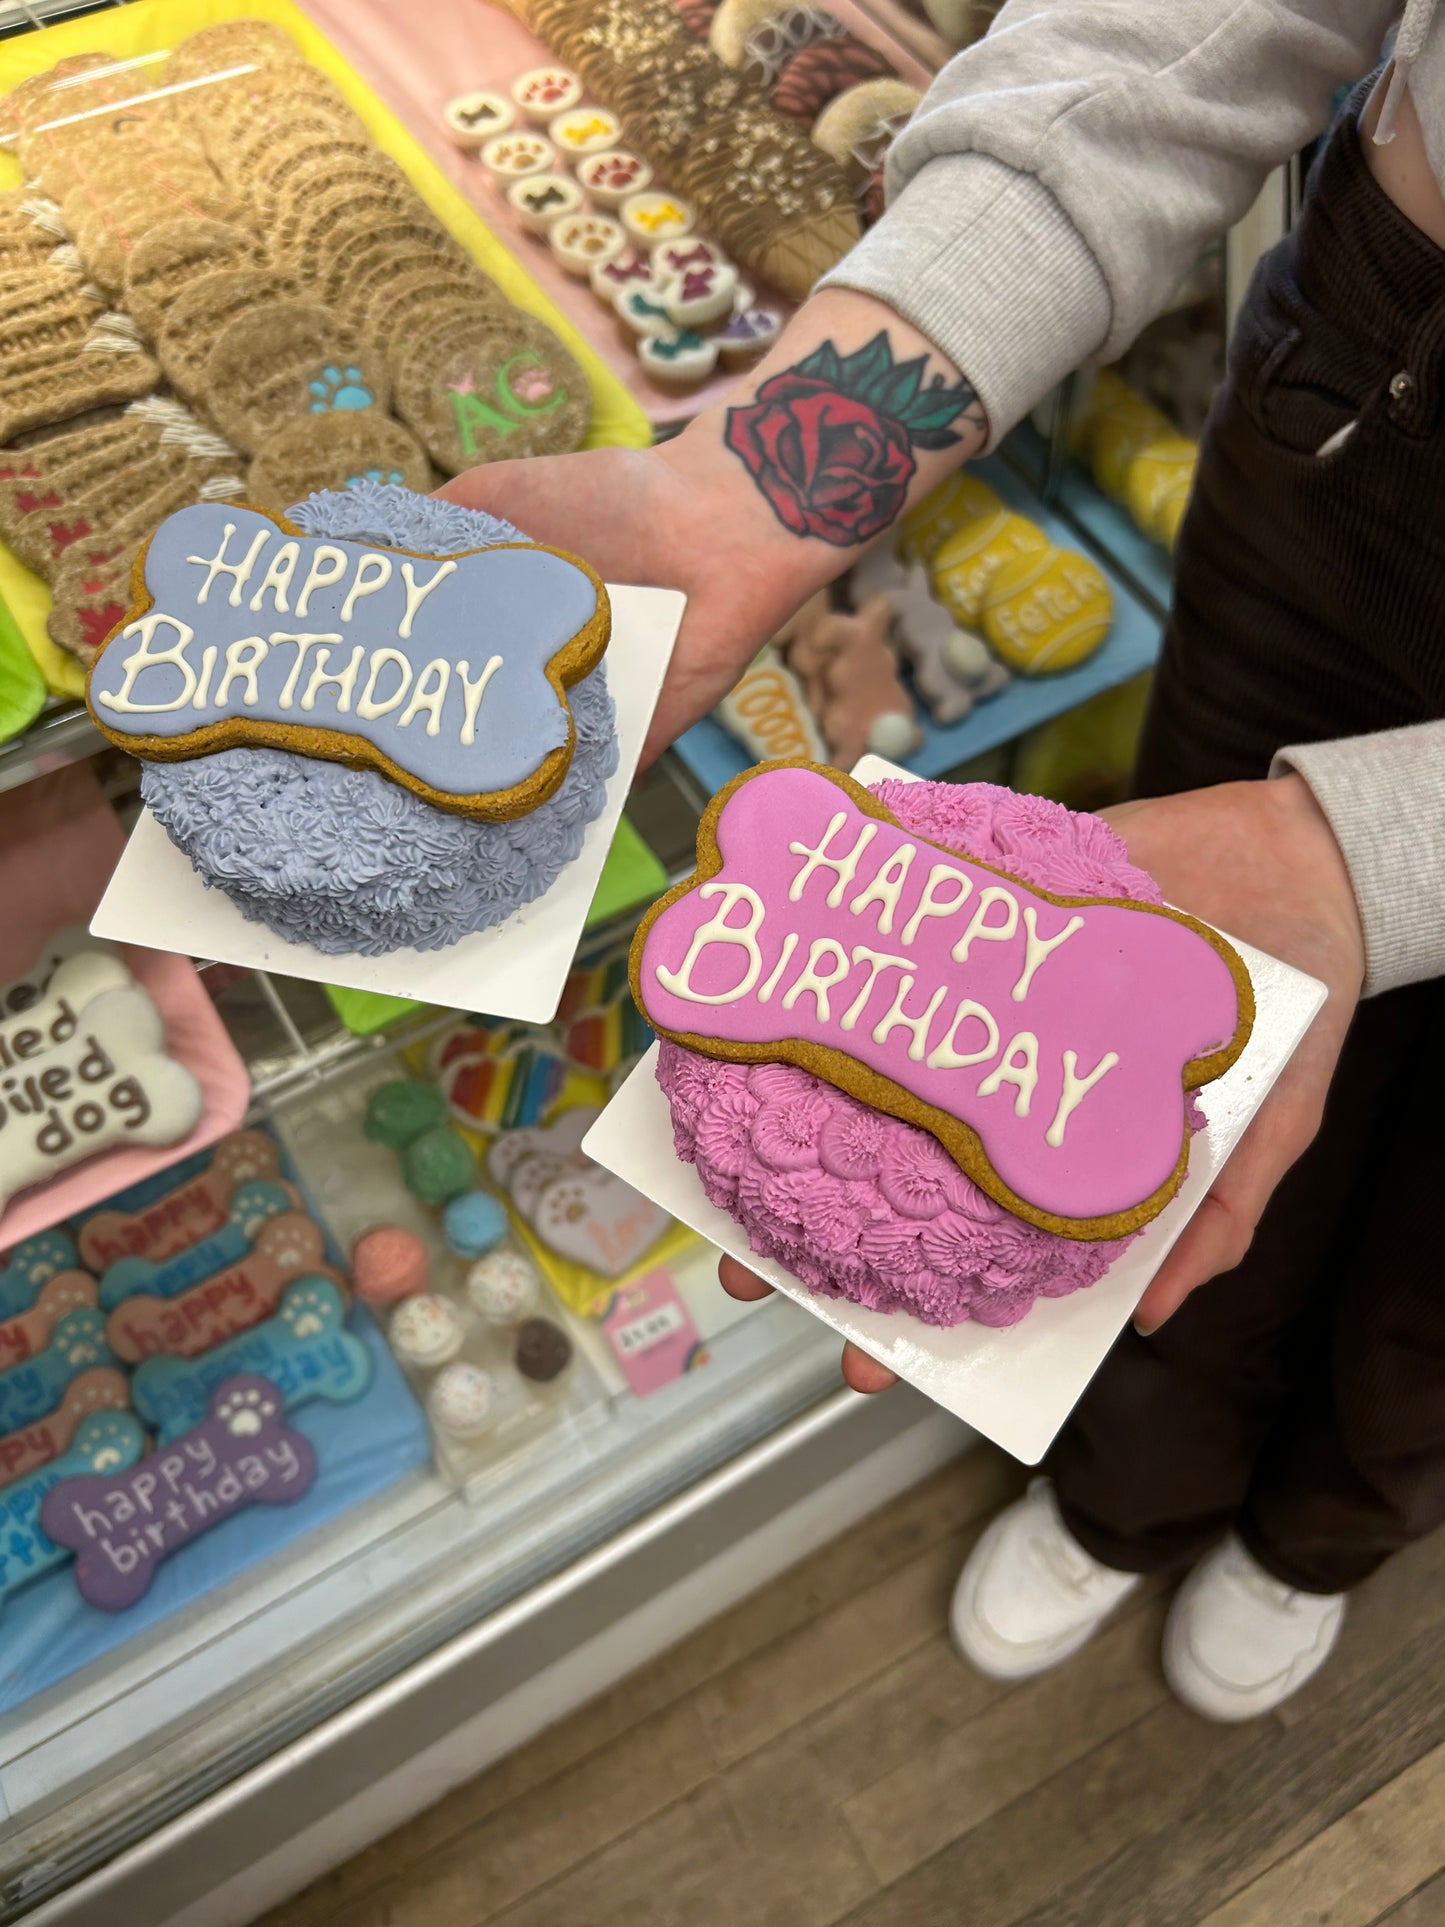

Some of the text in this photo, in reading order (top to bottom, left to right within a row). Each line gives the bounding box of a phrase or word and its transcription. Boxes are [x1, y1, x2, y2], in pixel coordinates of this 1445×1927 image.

[447, 347, 568, 457] AC
[186, 523, 458, 639] HAPPY
[98, 612, 504, 746] BIRTHDAY
[788, 811, 1085, 1003] HAPPY
[655, 882, 1120, 1148] BIRTHDAY
[36, 1073, 152, 1157] dog
[71, 1437, 218, 1539] happy
[100, 1438, 301, 1576] birthday
